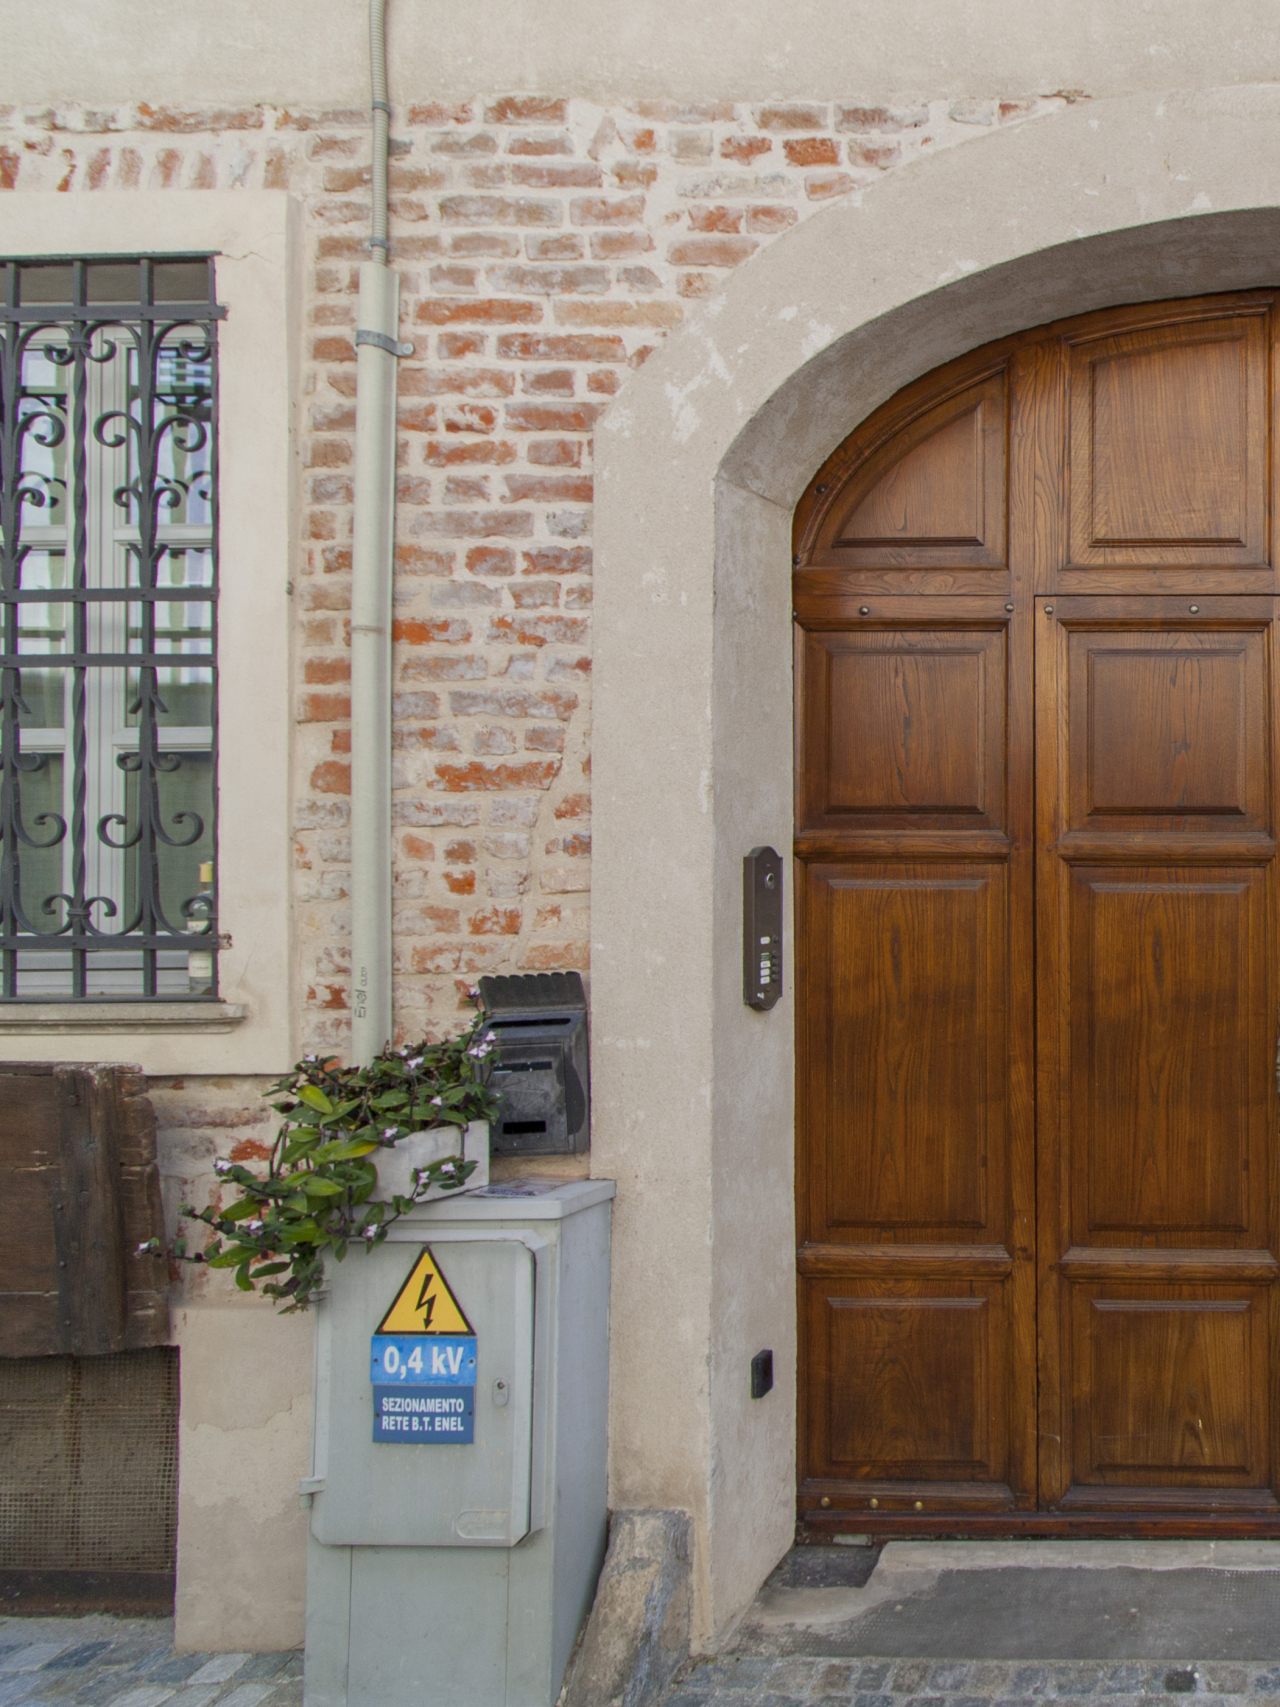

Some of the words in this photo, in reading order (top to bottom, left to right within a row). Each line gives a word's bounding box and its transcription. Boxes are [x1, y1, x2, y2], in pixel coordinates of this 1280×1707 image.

[354, 988, 367, 1018] Enel
[384, 1345, 424, 1380] 0,4
[432, 1346, 464, 1375] kV
[382, 1397, 464, 1413] SEZIONAMENTO
[382, 1416, 409, 1431] RETE
[412, 1417, 432, 1431] B.T.
[434, 1417, 464, 1431] ENEL
